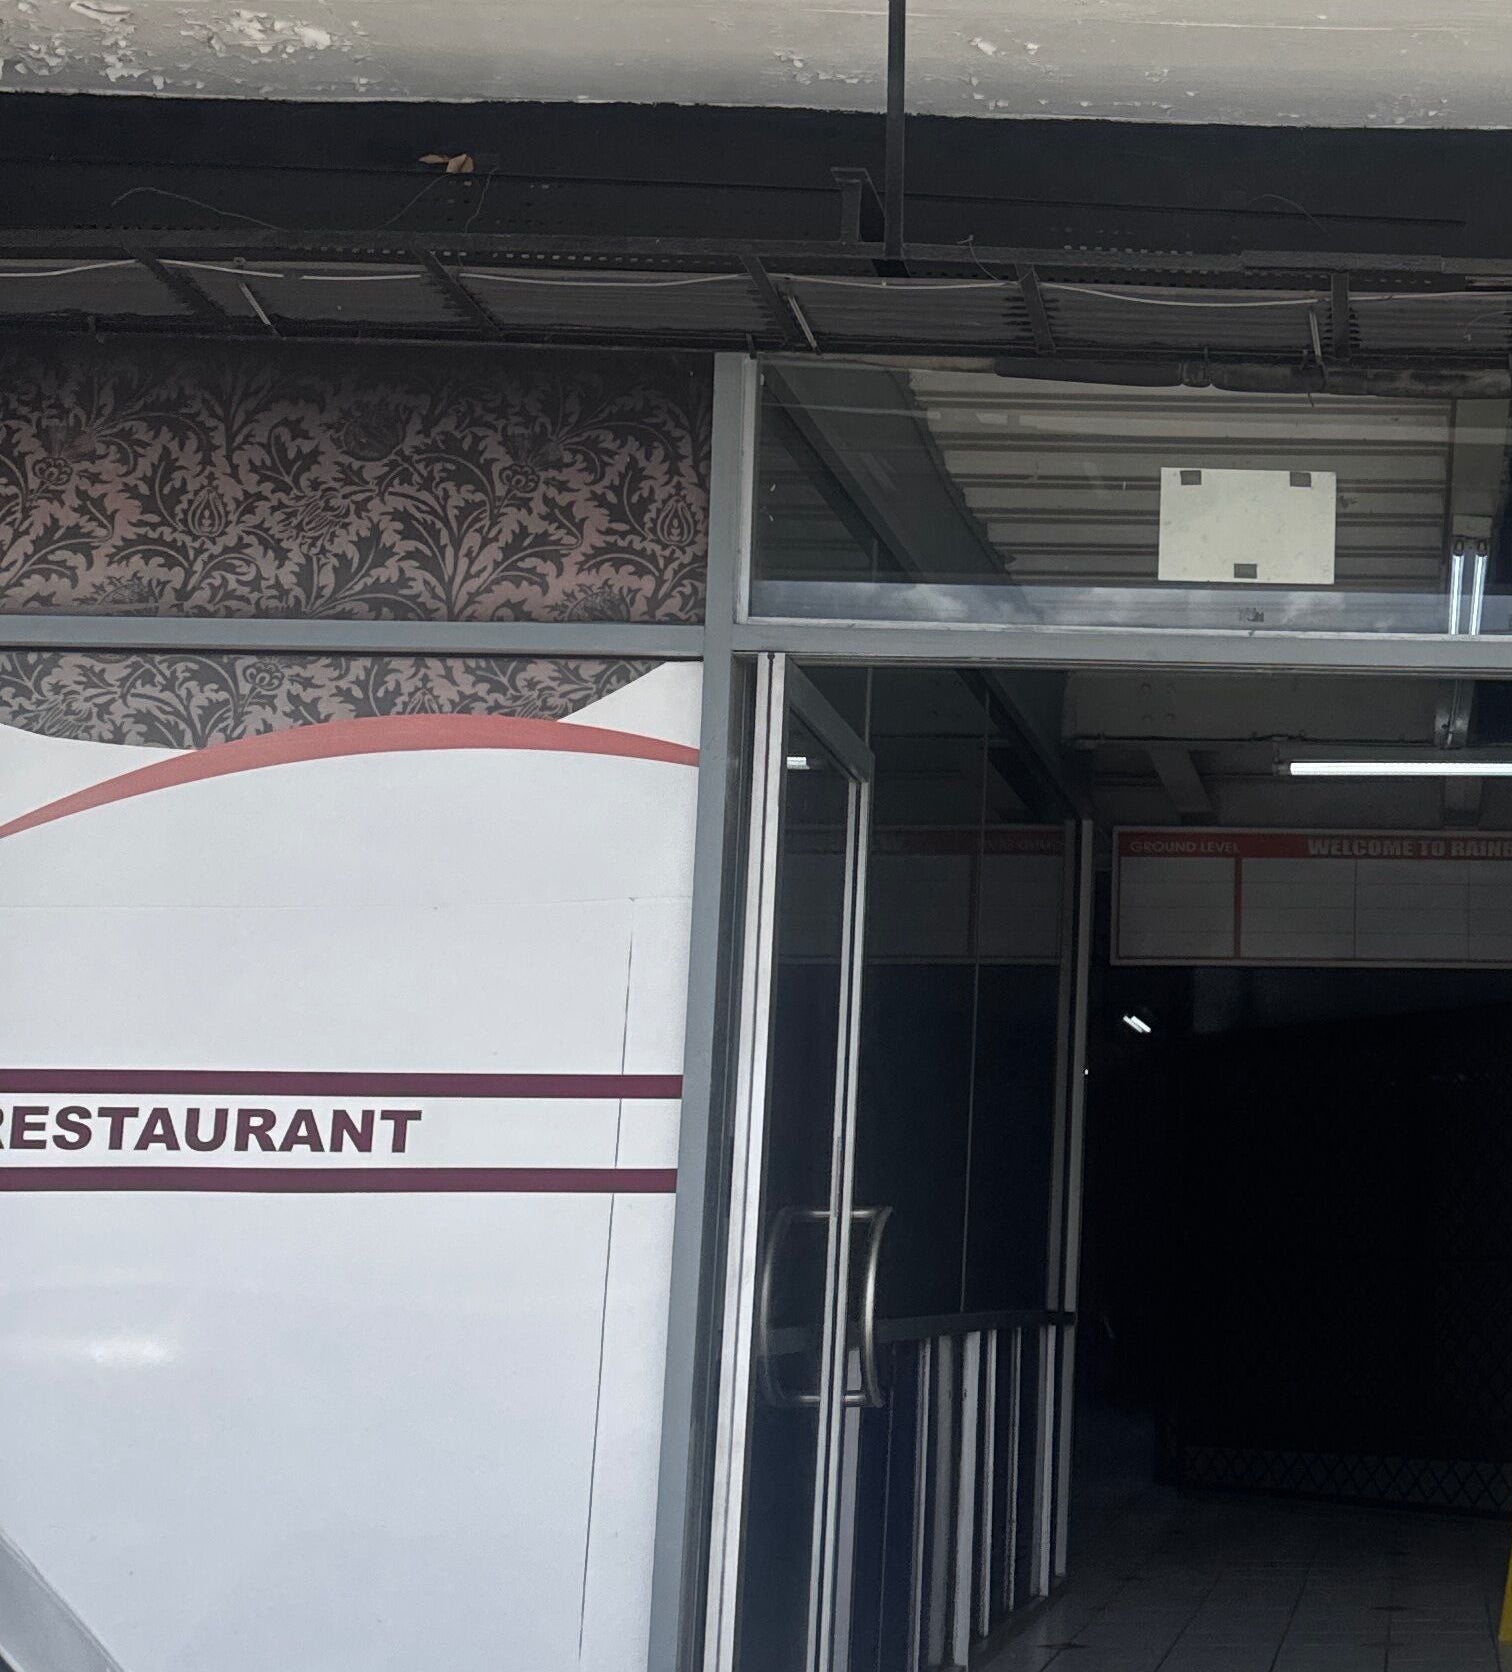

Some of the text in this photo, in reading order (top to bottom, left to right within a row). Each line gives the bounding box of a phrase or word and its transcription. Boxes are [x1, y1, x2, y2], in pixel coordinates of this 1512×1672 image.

[1130, 840, 1240, 854] GROUND LEVEL
[1308, 838, 1414, 856] WELCOME
[1420, 840, 1447, 856] TO
[0, 1105, 422, 1153] ESTAURANT
